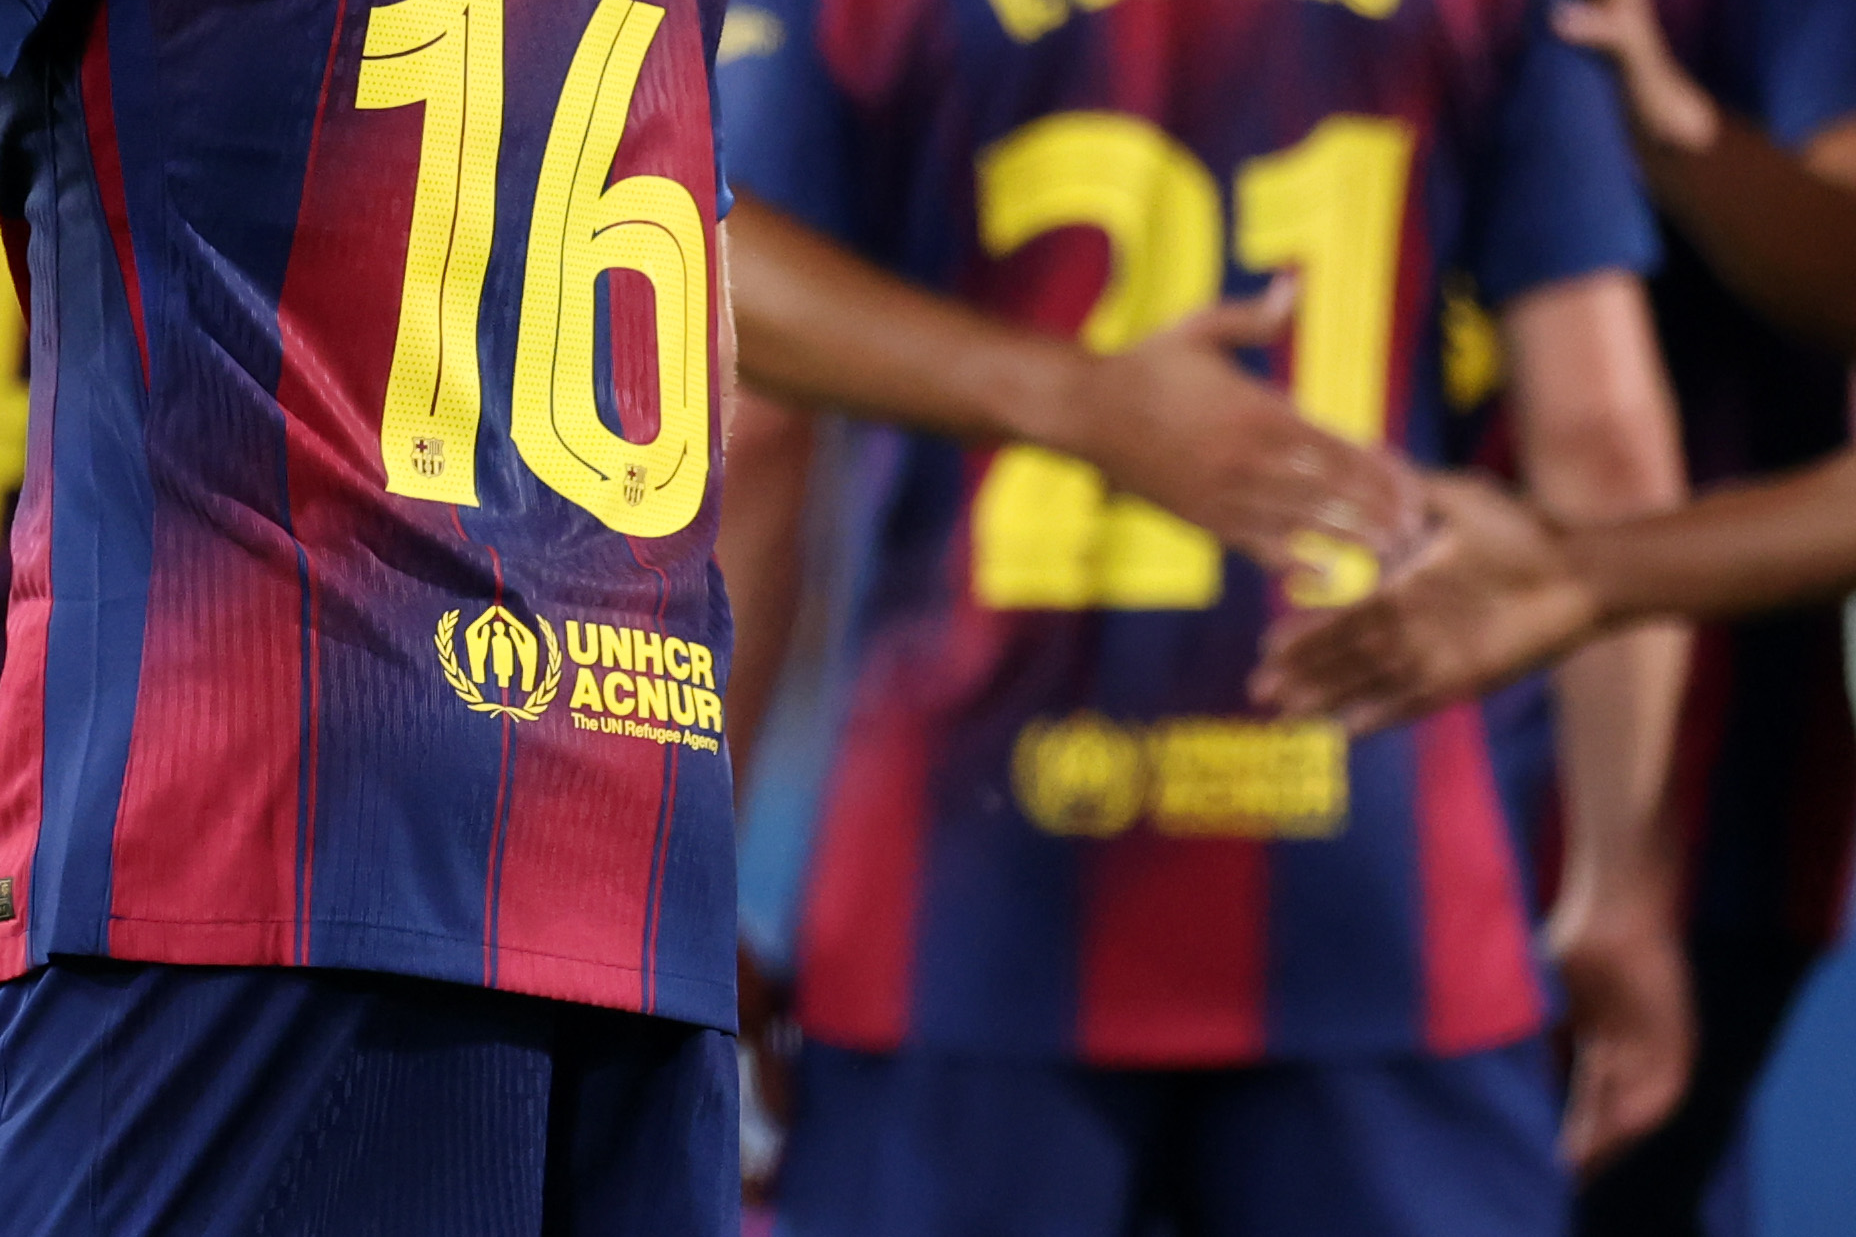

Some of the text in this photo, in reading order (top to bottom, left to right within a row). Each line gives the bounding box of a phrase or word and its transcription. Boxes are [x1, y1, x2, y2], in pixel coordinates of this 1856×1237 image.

[973, 110, 1416, 612] 21
[565, 619, 717, 691] UNHCR
[568, 666, 723, 733] ACNUR
[570, 711, 599, 732] The
[600, 715, 624, 736] UN
[624, 719, 682, 745] Refugee
